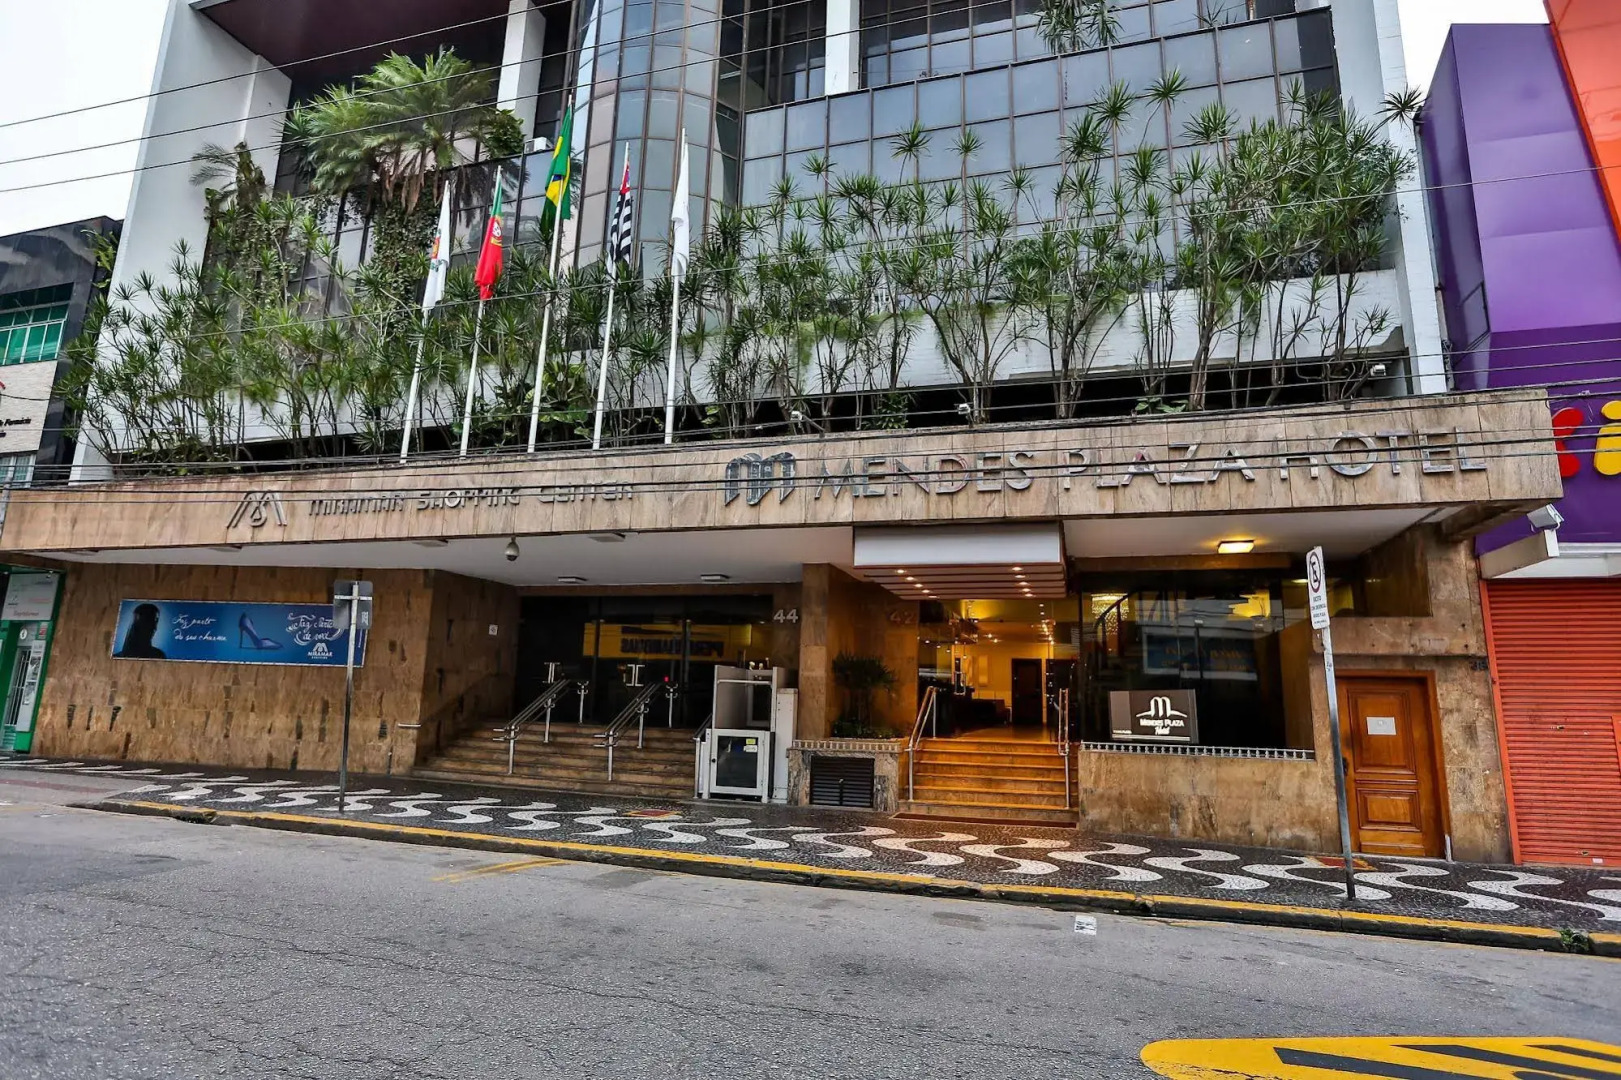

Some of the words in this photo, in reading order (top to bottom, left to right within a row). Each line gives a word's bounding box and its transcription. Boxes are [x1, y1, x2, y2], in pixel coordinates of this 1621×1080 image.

[814, 450, 1034, 500] MENDES
[1063, 442, 1256, 490] PLAZA
[1279, 426, 1487, 479] HOTEL
[417, 486, 520, 511] SHOPPING
[538, 480, 633, 503] CENTER
[773, 608, 799, 623] 44
[1139, 718, 1164, 727] MENDES
[1164, 719, 1185, 727] PLAZA
